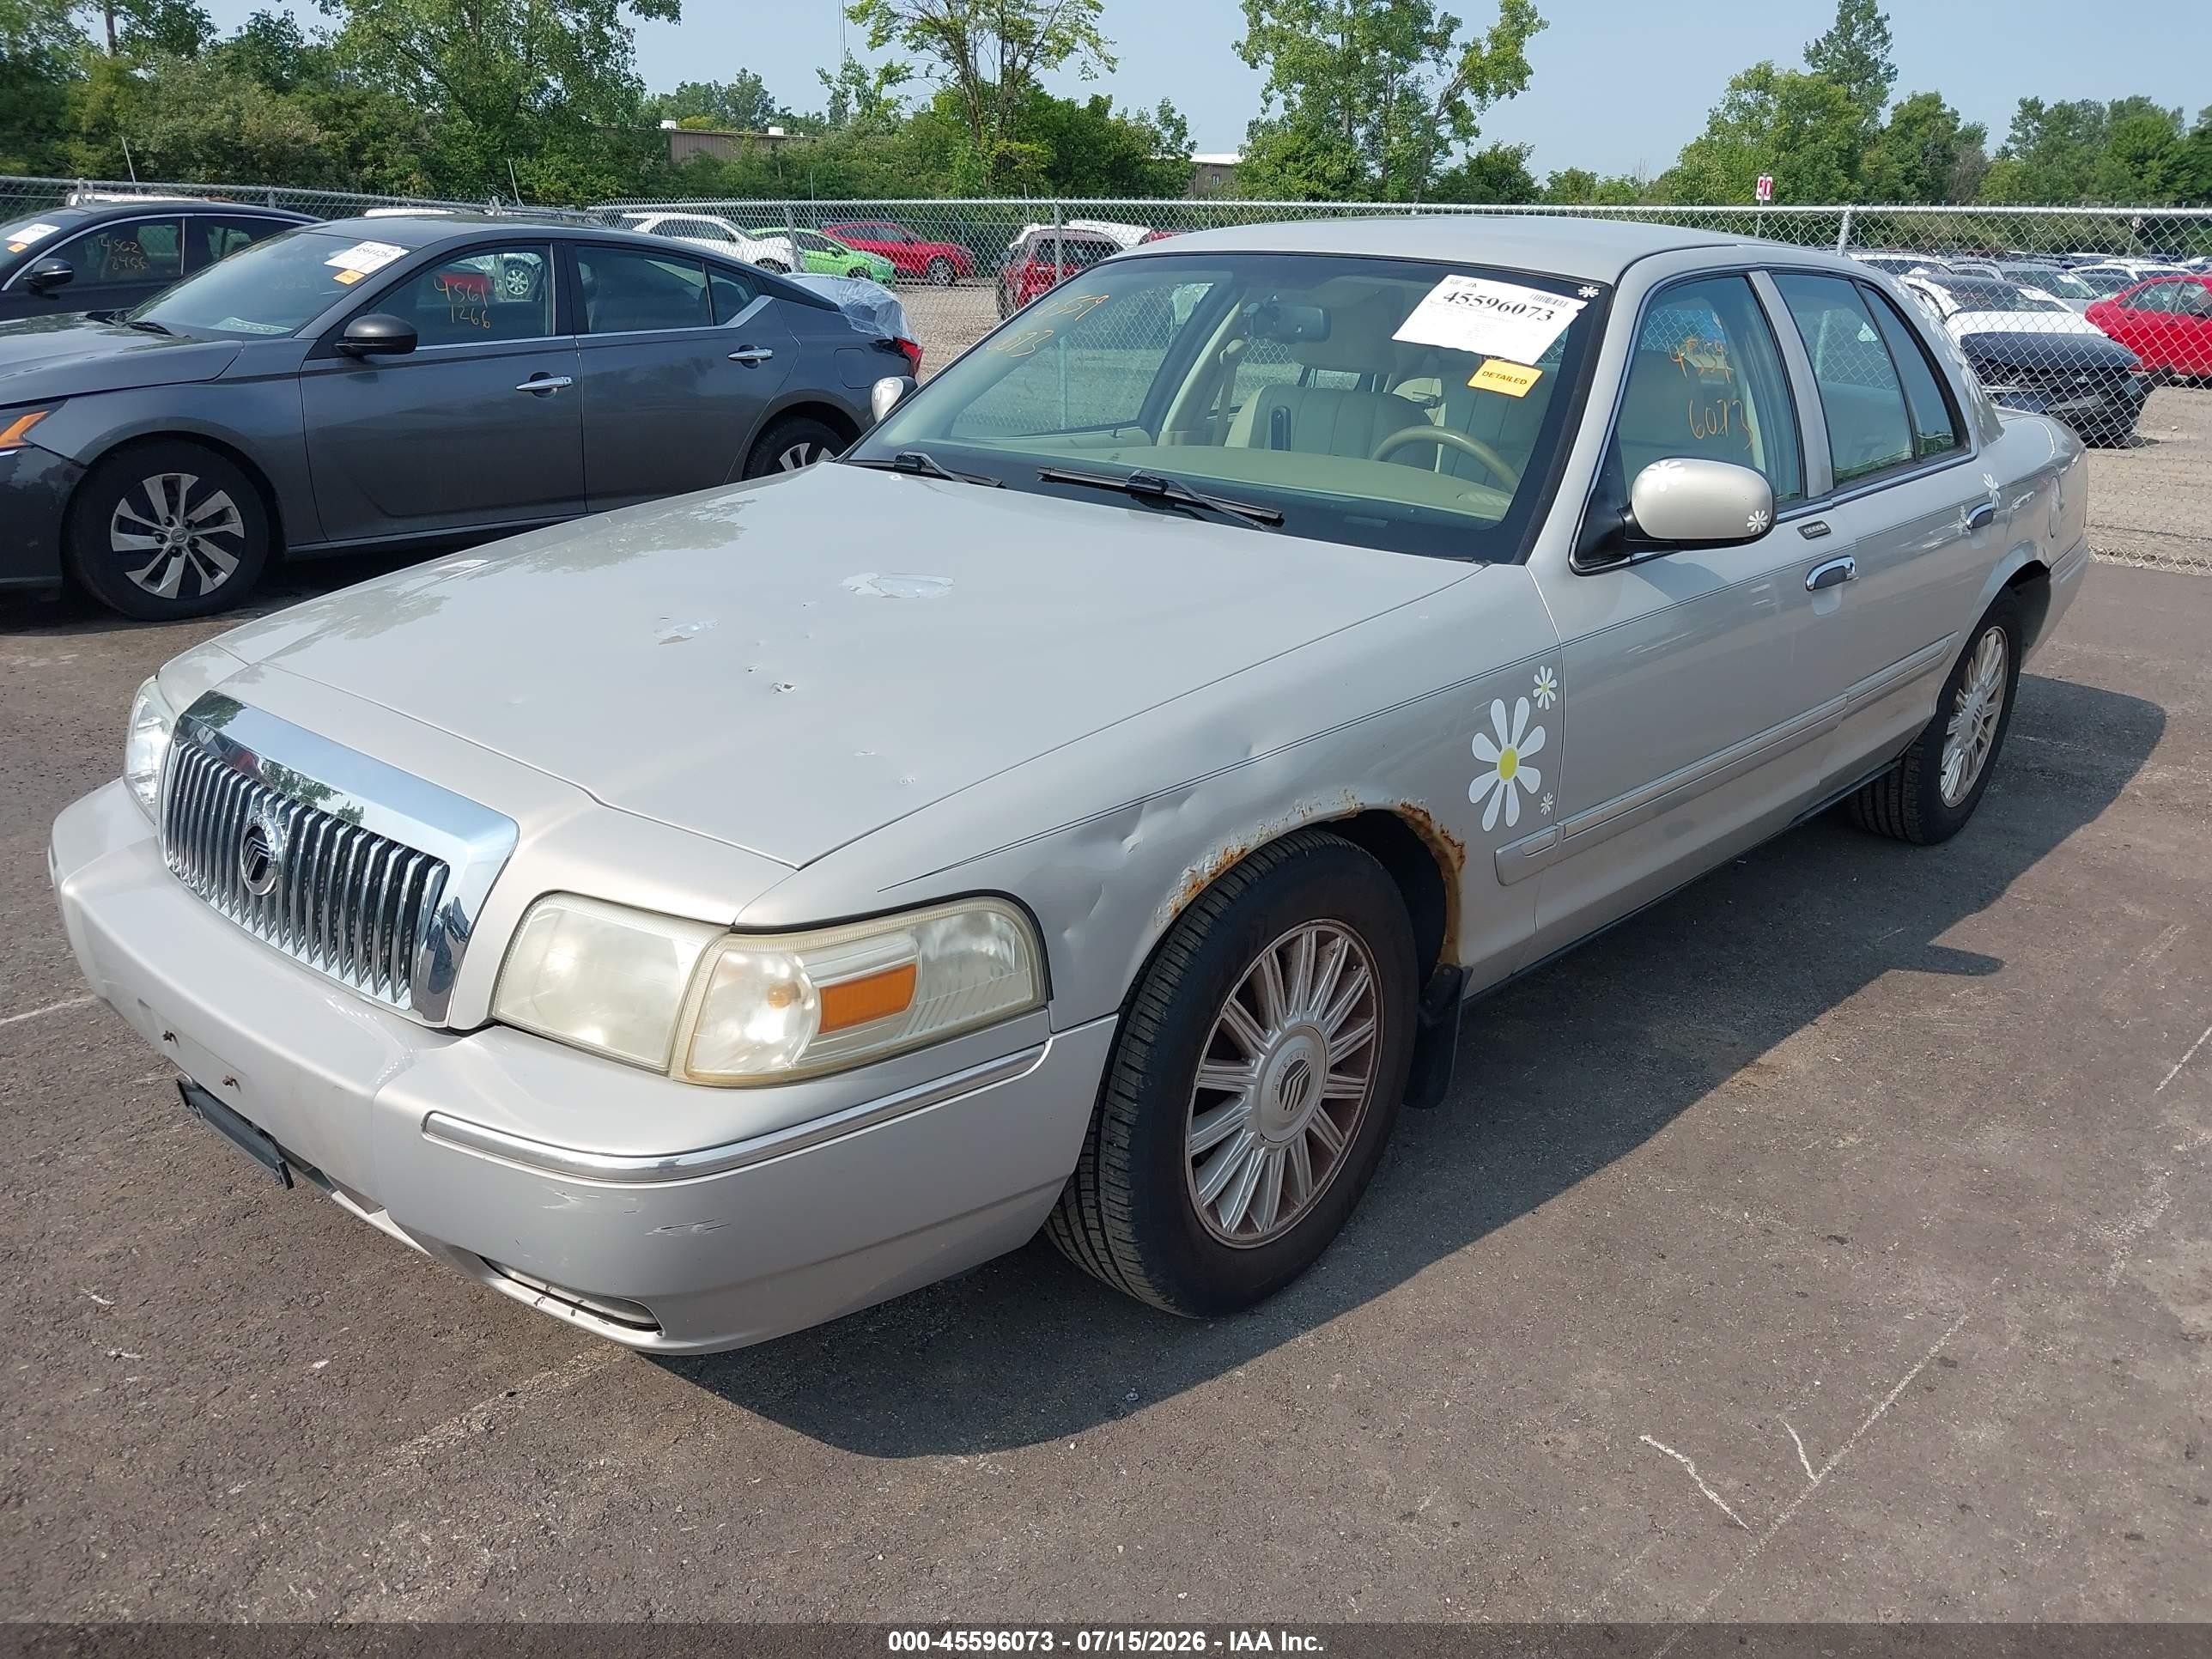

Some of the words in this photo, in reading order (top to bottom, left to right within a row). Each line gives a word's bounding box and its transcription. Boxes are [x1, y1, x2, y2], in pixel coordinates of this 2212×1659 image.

[434, 277, 489, 308] 4561
[1443, 290, 1556, 323] 45596073
[451, 304, 490, 329] 1266
[1481, 371, 1528, 386] DETAILED
[1689, 399, 1753, 451] 6073
